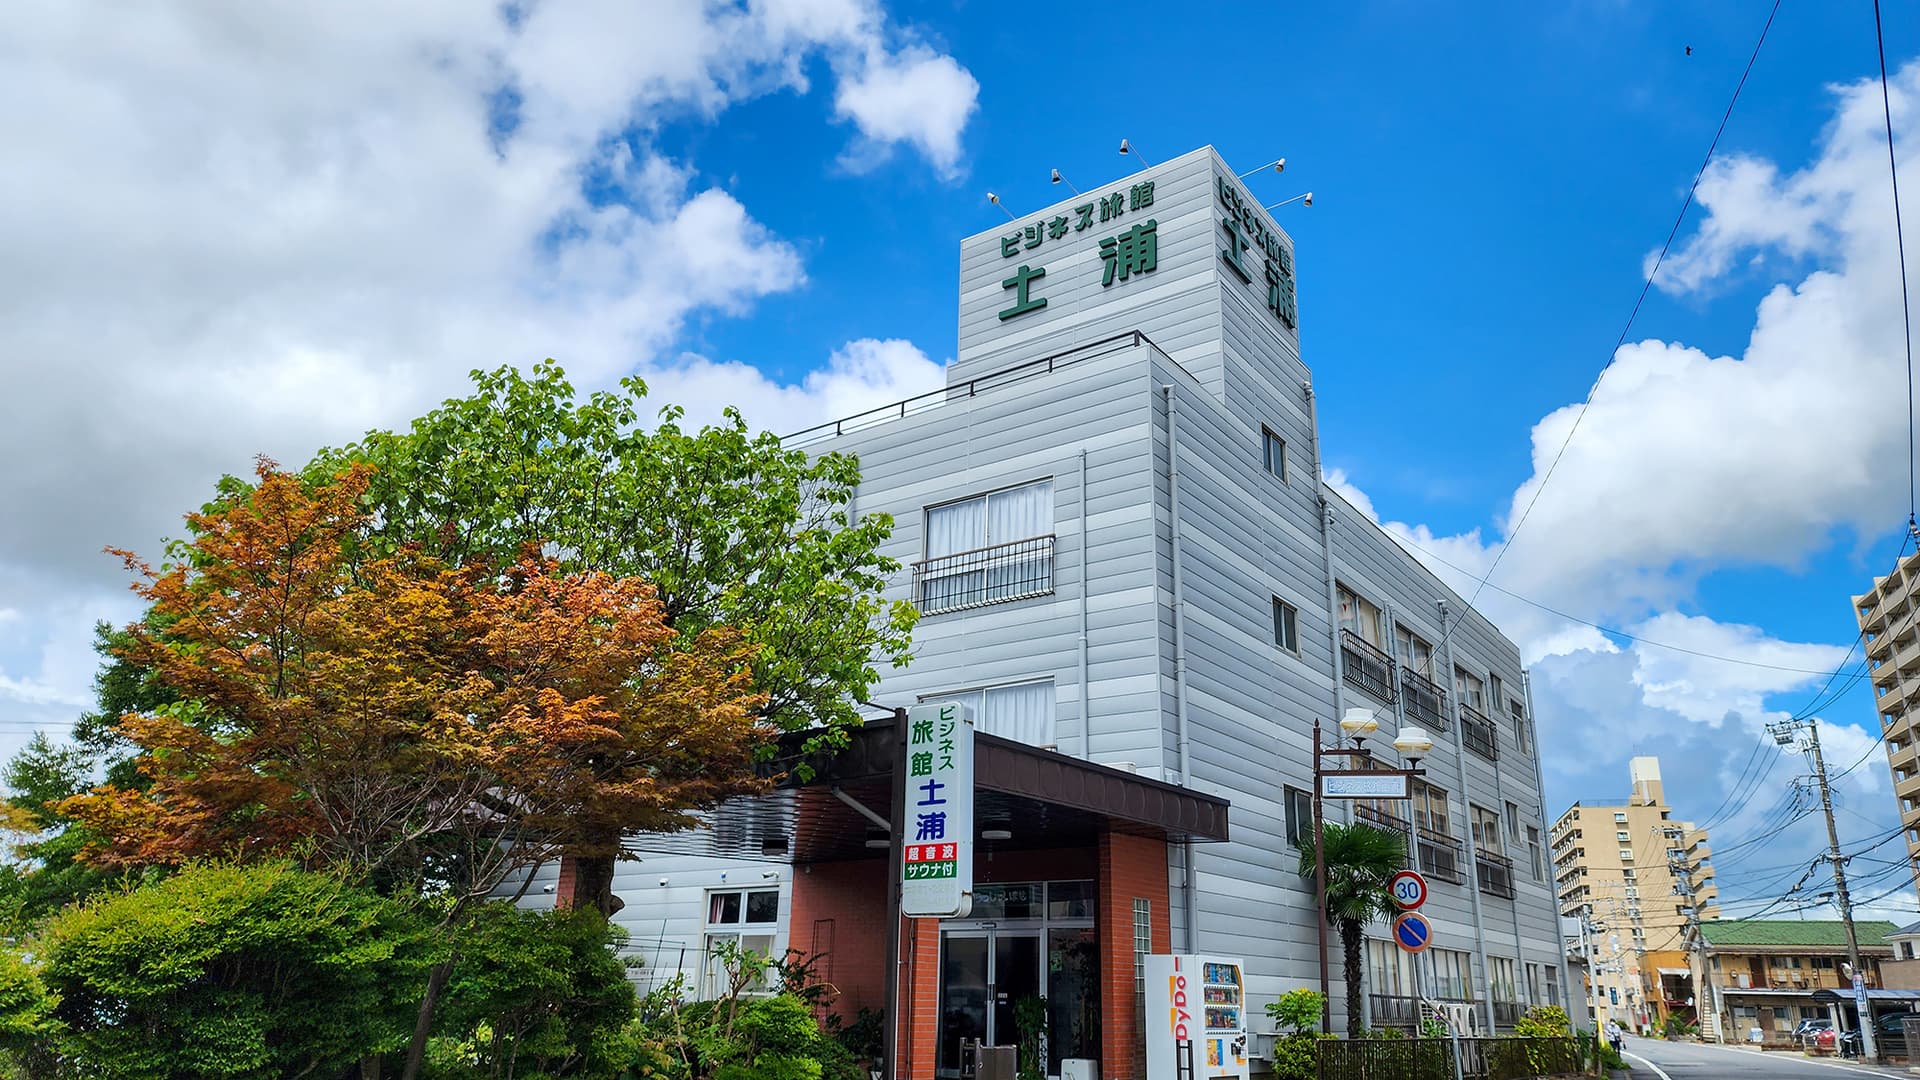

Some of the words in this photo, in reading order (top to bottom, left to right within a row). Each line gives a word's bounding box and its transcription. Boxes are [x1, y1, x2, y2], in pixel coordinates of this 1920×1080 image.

[1000, 181, 1155, 258] ビジネス旅館
[998, 218, 1158, 322] 土浦
[1222, 217, 1296, 330] 土浦
[911, 719, 935, 778] 旅館
[938, 705, 956, 771] ビジネス
[915, 778, 948, 841] 土浦
[907, 845, 955, 861] 超音波
[907, 862, 955, 878] サウナ付
[1396, 882, 1419, 899] 30
[1174, 975, 1192, 1040] DyDo
